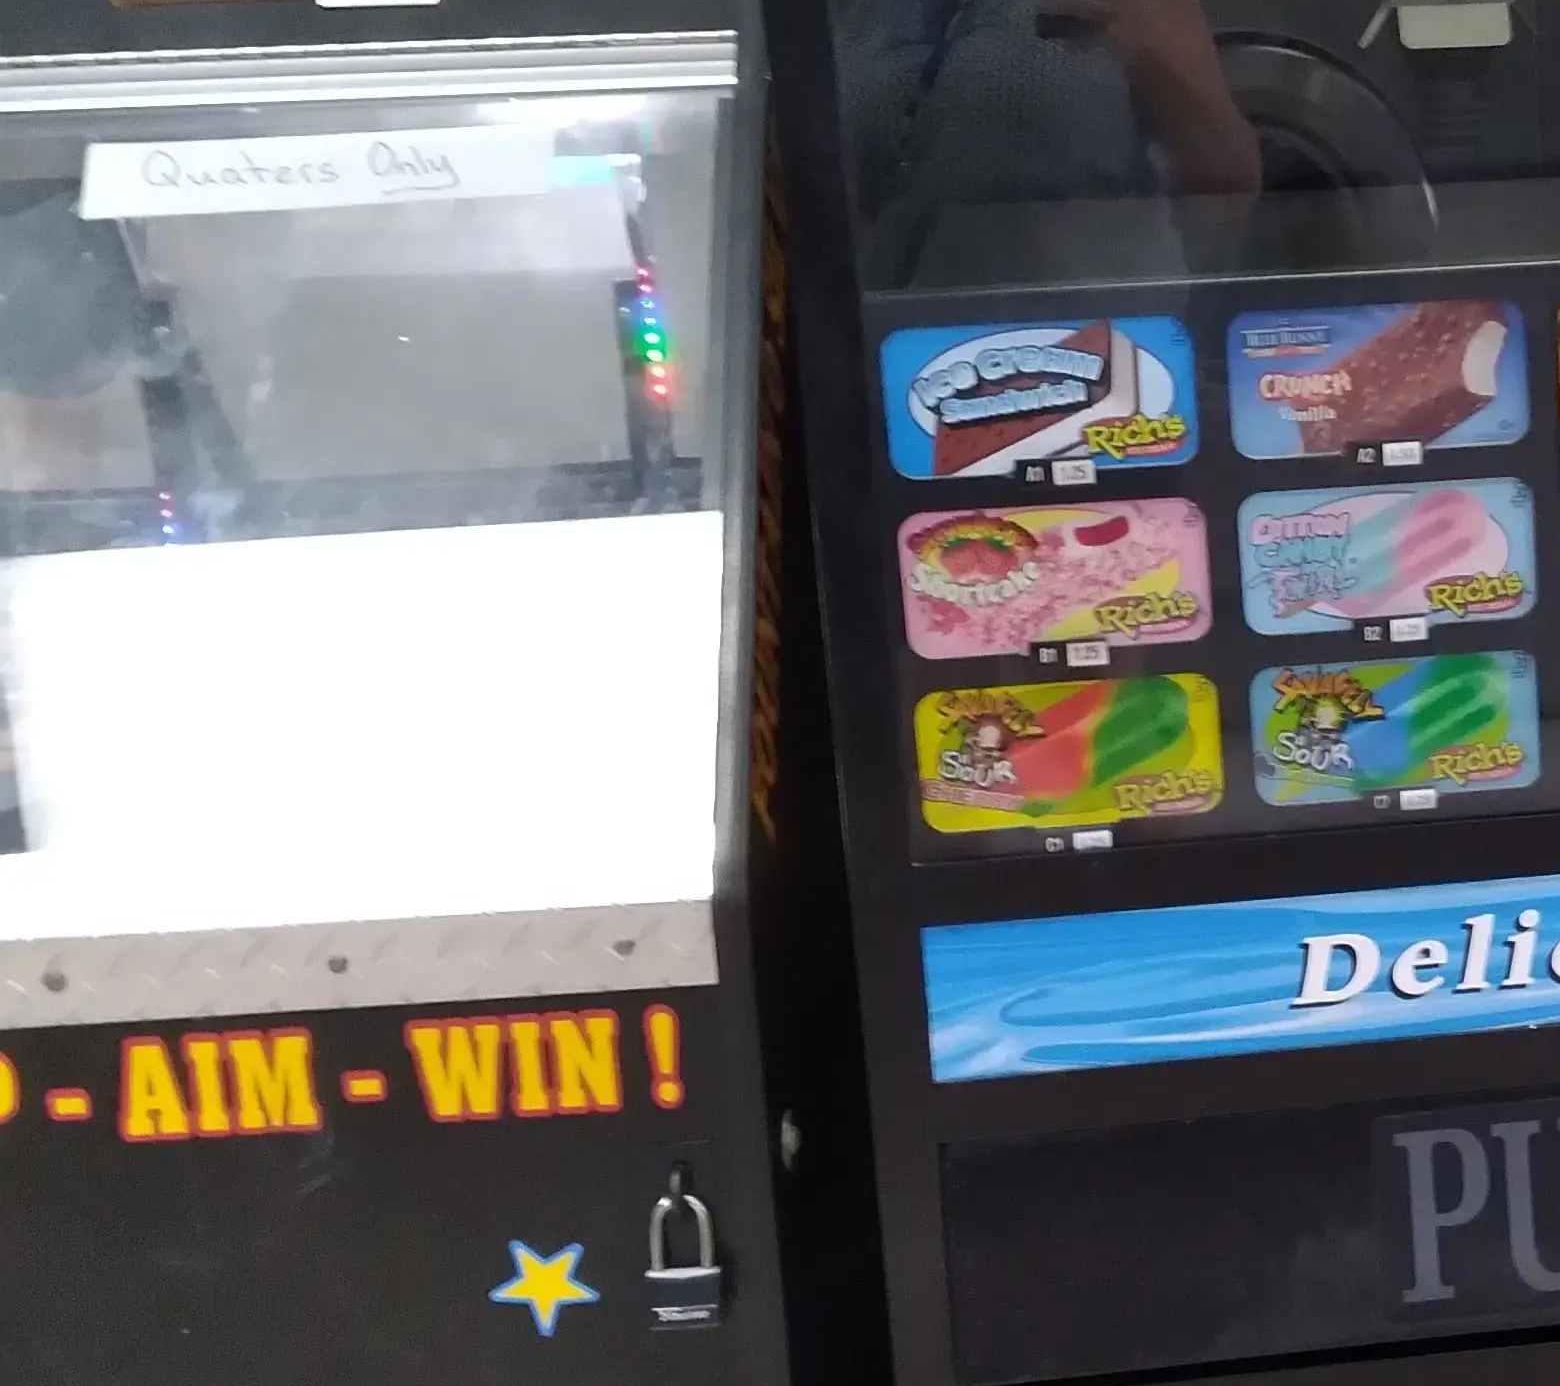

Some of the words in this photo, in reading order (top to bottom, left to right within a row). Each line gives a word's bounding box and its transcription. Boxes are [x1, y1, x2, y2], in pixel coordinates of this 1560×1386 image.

[366, 140, 461, 191] Only
[1259, 369, 1353, 398] CRUNCH
[120, 1027, 322, 1141] AIM
